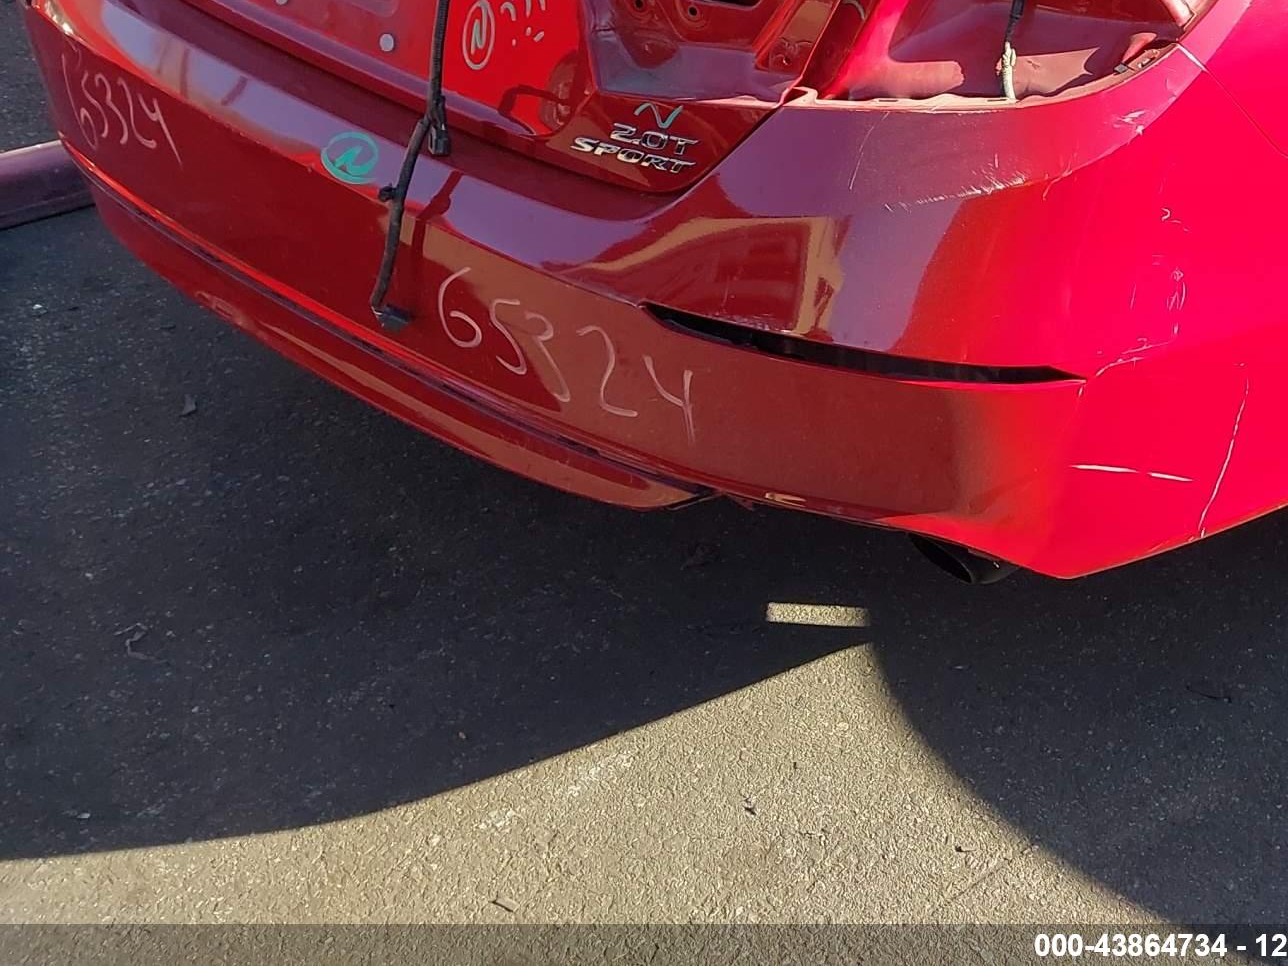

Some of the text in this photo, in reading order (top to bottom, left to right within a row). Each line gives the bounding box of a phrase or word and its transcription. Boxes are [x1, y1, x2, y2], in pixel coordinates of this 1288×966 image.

[570, 137, 696, 173] SPORT
[610, 122, 699, 155] 2.0T
[438, 266, 695, 447] 65324
